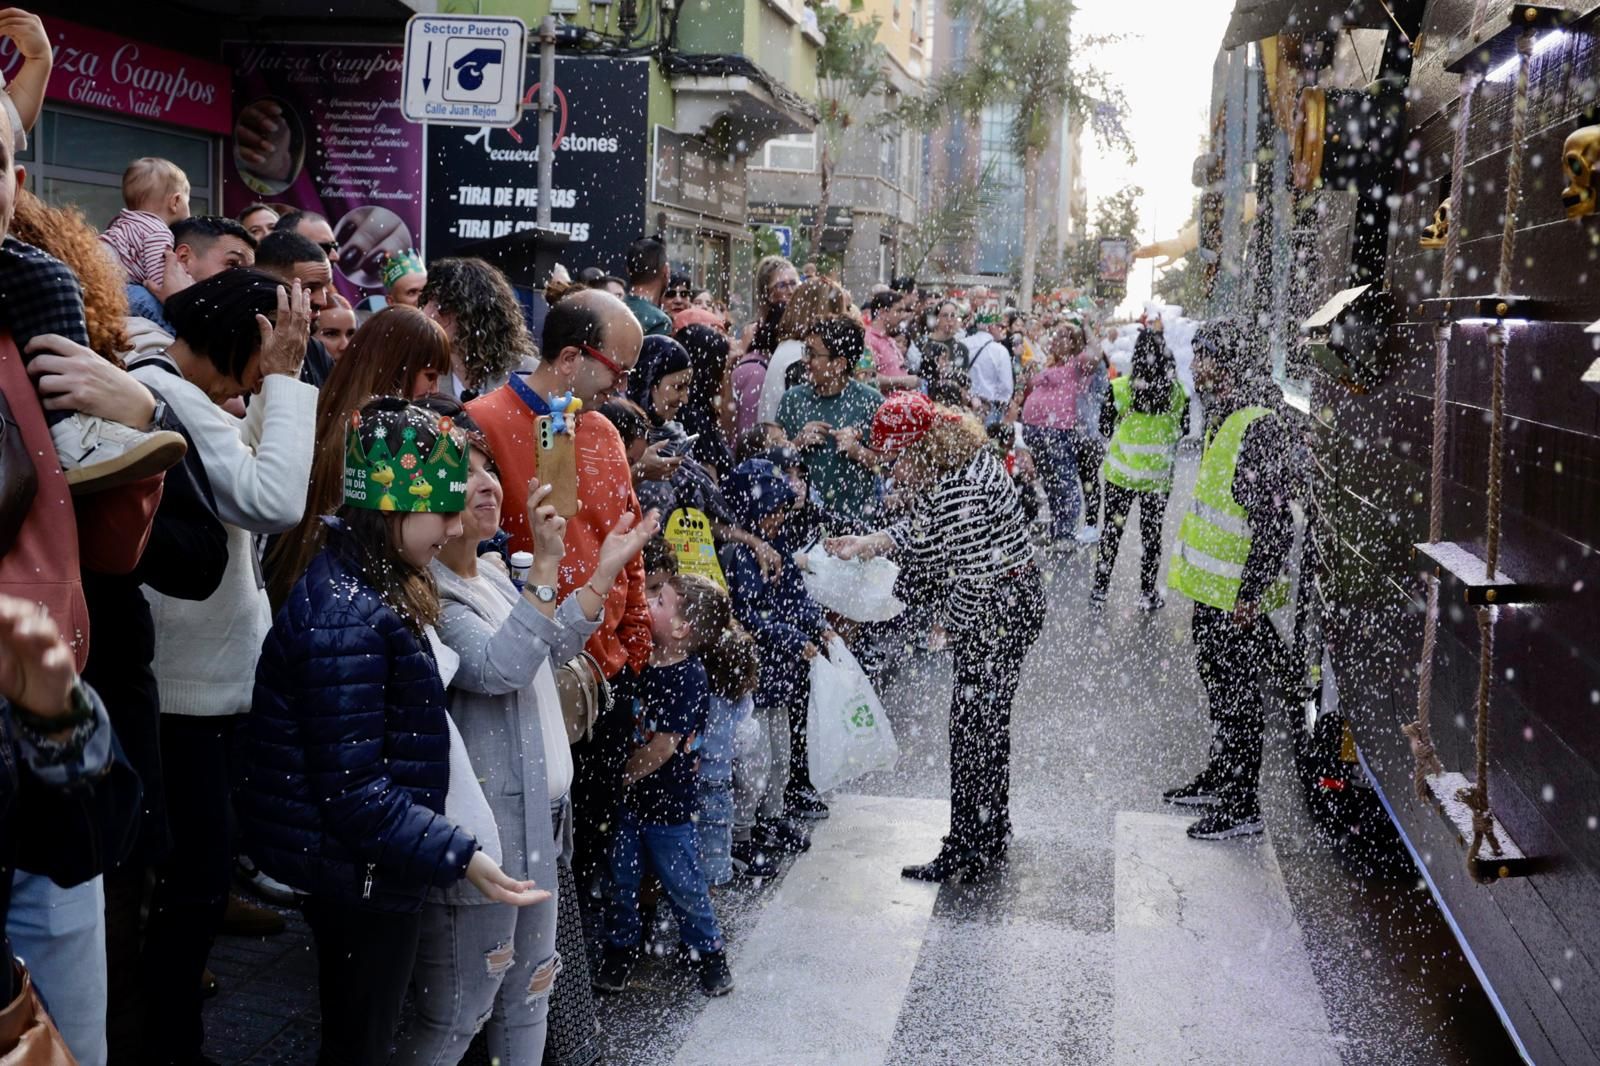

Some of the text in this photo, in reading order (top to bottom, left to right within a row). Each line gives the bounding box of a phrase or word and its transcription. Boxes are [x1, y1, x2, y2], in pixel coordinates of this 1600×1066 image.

[423, 22, 510, 36] Sector Puerto
[111, 43, 216, 112] Campos
[68, 76, 162, 118] Clinic Nails
[425, 103, 447, 114] Calle
[449, 104, 470, 115] Juan
[560, 132, 619, 152] stones
[493, 187, 514, 207] DE
[514, 187, 577, 208] PIERAS
[492, 220, 514, 239] DE
[357, 469, 367, 479] ES
[354, 479, 366, 489] DÍA
